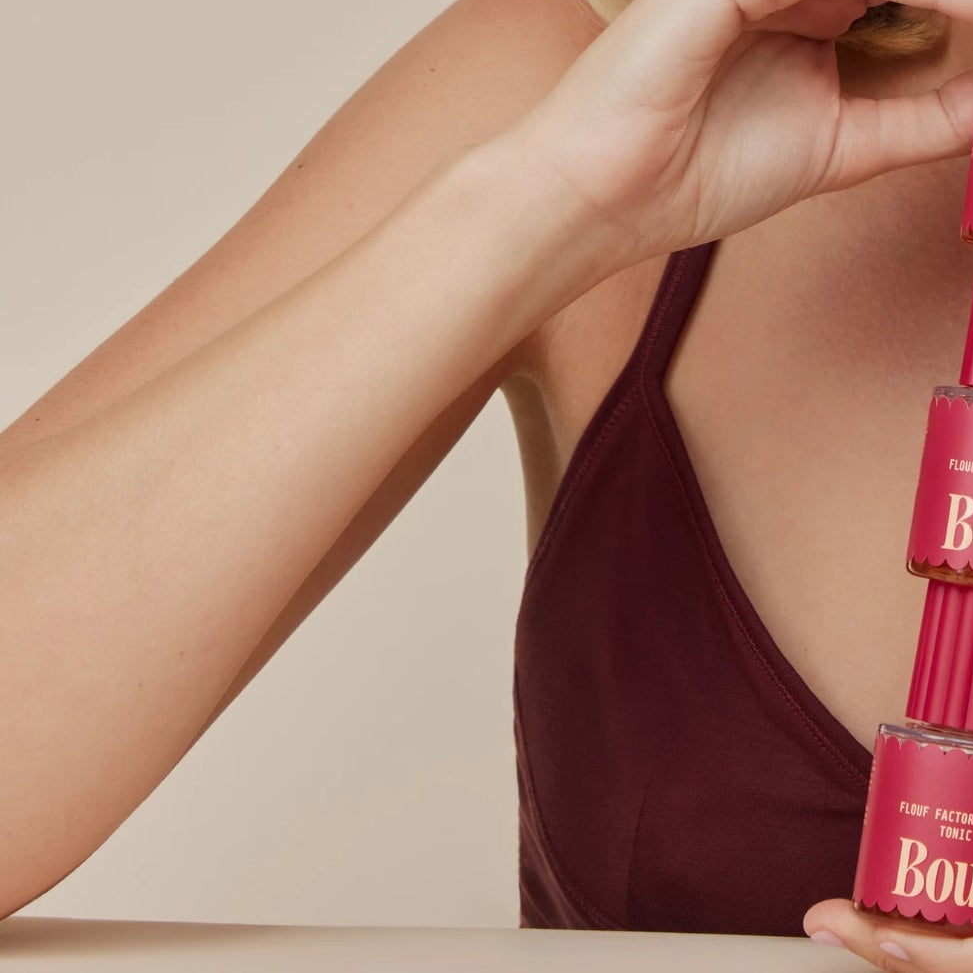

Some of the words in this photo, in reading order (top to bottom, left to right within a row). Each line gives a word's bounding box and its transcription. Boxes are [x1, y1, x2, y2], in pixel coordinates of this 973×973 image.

[899, 801, 930, 817] FLOUF
[934, 808, 973, 825] FACTOR
[939, 825, 973, 842] TONIC
